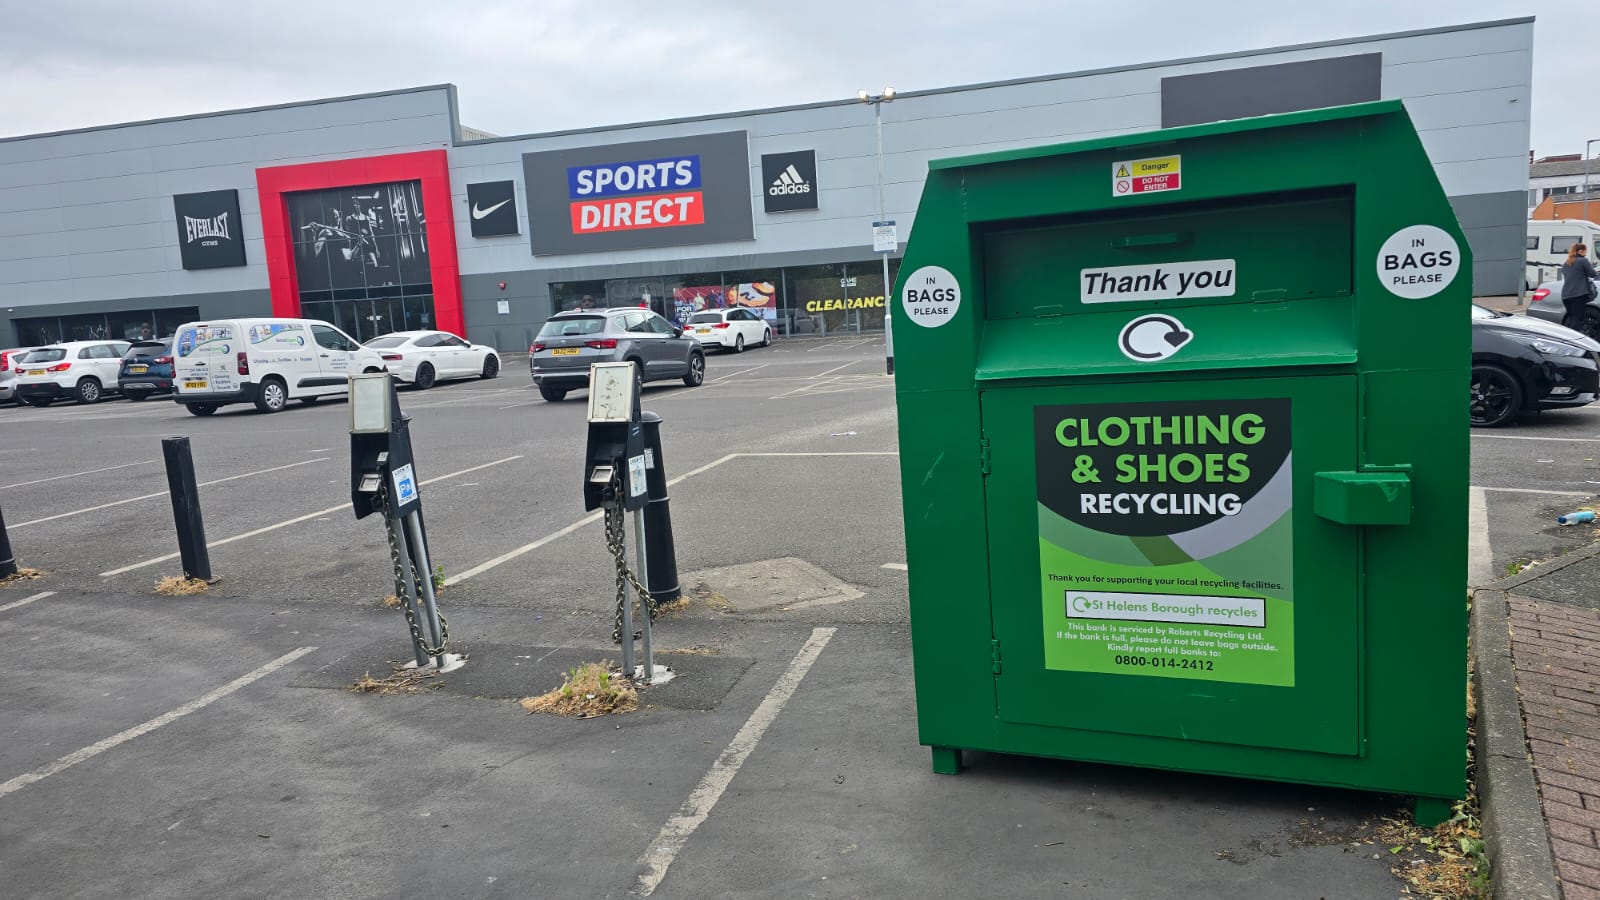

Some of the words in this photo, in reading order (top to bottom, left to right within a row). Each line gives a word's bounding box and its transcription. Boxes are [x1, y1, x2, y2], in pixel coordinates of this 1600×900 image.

[1141, 162, 1170, 171] Danger
[576, 159, 693, 195] SPORTS
[1154, 175, 1169, 183] NOT
[769, 181, 810, 196] adidas
[1143, 183, 1168, 191] ENTER
[580, 196, 695, 230] DIRECT
[184, 211, 231, 244] EVERLAST
[1411, 238, 1425, 248] IN
[1384, 250, 1453, 270] BAGS
[926, 277, 936, 285] IN
[1084, 268, 1170, 295] Thank
[1176, 269, 1233, 296] you
[1393, 273, 1442, 285] PLEASE
[907, 288, 956, 303] BAGS
[914, 307, 949, 316] PLEASE
[1055, 413, 1266, 447] CLOTHING
[1071, 454, 1102, 484] &
[1115, 452, 1250, 483] SHOES
[1080, 492, 1243, 516] RECYCLING
[1048, 573, 1073, 582] Thank
[1107, 576, 1153, 585] supporting
[1155, 578, 1174, 586] your
[1177, 578, 1198, 586] local
[1200, 579, 1240, 589] recycling
[1242, 580, 1284, 590] facilities.
[1092, 600, 1104, 610] St
[1107, 600, 1148, 611] Helens
[1151, 602, 1204, 617] Borough
[1207, 605, 1258, 618] recycles
[1067, 622, 1084, 631] This
[1086, 623, 1107, 631] bank
[1110, 624, 1117, 632] is
[1118, 625, 1153, 634] serviced
[1155, 626, 1166, 636] by
[1168, 627, 1201, 637] Roberts
[1203, 629, 1245, 640] Recycling
[1247, 632, 1264, 641] Ltd.
[1056, 631, 1063, 639] If
[1080, 632, 1100, 641] bank
[1102, 633, 1109, 641] is
[1111, 634, 1128, 643] full,
[1130, 635, 1158, 644] please
[1160, 636, 1172, 645] do
[1191, 639, 1215, 647] leave
[1217, 640, 1239, 650] bags
[1241, 642, 1279, 651] outside.
[1107, 642, 1134, 653] Kindly
[1136, 646, 1162, 654] report
[1164, 646, 1179, 654] full
[1180, 647, 1207, 656] banks
[1115, 654, 1214, 671] 0800-014-2412
